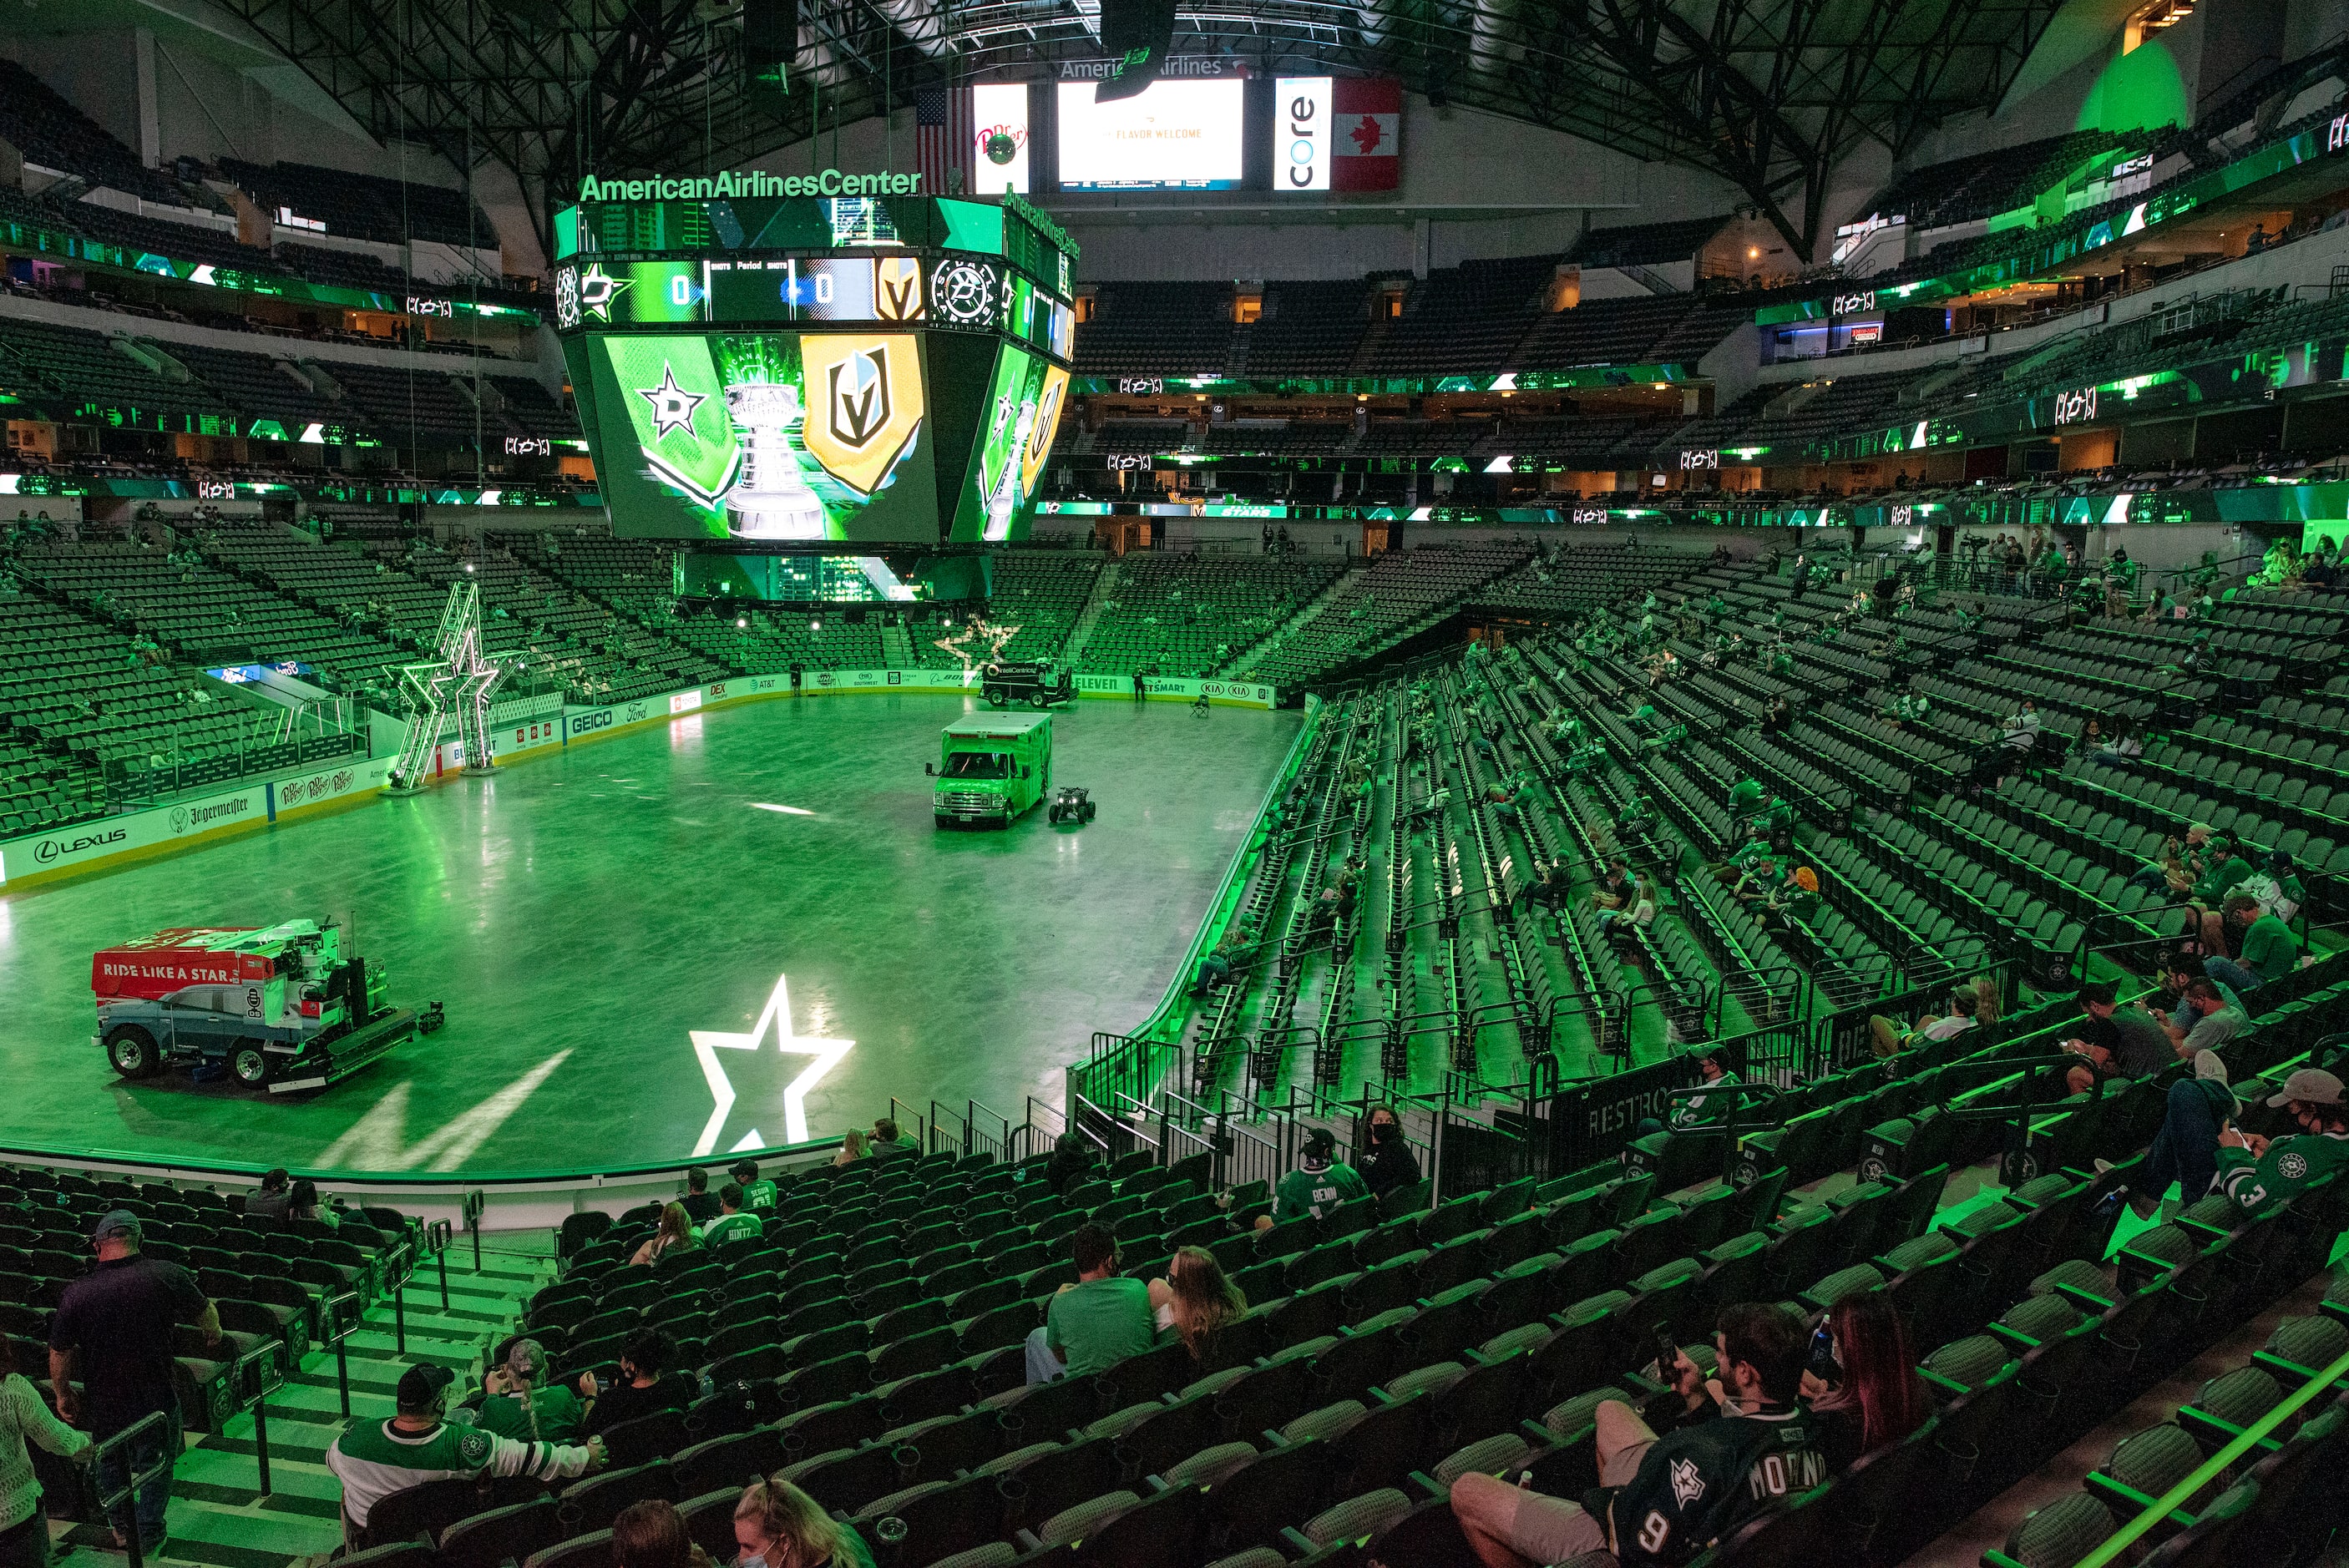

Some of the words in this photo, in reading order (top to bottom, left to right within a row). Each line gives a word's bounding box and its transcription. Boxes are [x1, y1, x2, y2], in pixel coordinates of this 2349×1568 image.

[1061, 58, 1122, 78] Americ
[1116, 130, 1152, 139] FLAVOR
[1156, 129, 1202, 139] WELCOME
[1289, 96, 1314, 188] core
[737, 261, 762, 271] Period
[671, 276, 690, 306] 0
[816, 274, 833, 303] 0
[711, 683, 726, 695] DEX
[759, 680, 776, 689] AT&T
[1143, 680, 1185, 692] ETSMART
[627, 702, 647, 722] Ford
[573, 711, 612, 734] GEICO
[315, 776, 323, 786] Dr
[332, 773, 352, 792] Pepper
[339, 770, 347, 780] Dr
[282, 784, 303, 805] Pepper
[289, 781, 298, 793] Dr
[307, 778, 328, 798] Pepper
[60, 828, 127, 854] LEXUS
[104, 964, 139, 978] RIDE
[141, 965, 175, 979] LIKE
[177, 968, 188, 980] A
[751, 1186, 770, 1197] SEGUIN
[1312, 1186, 1337, 1202] BENN
[2240, 1184, 2267, 1207] 3
[1638, 1509, 1670, 1554] 9
